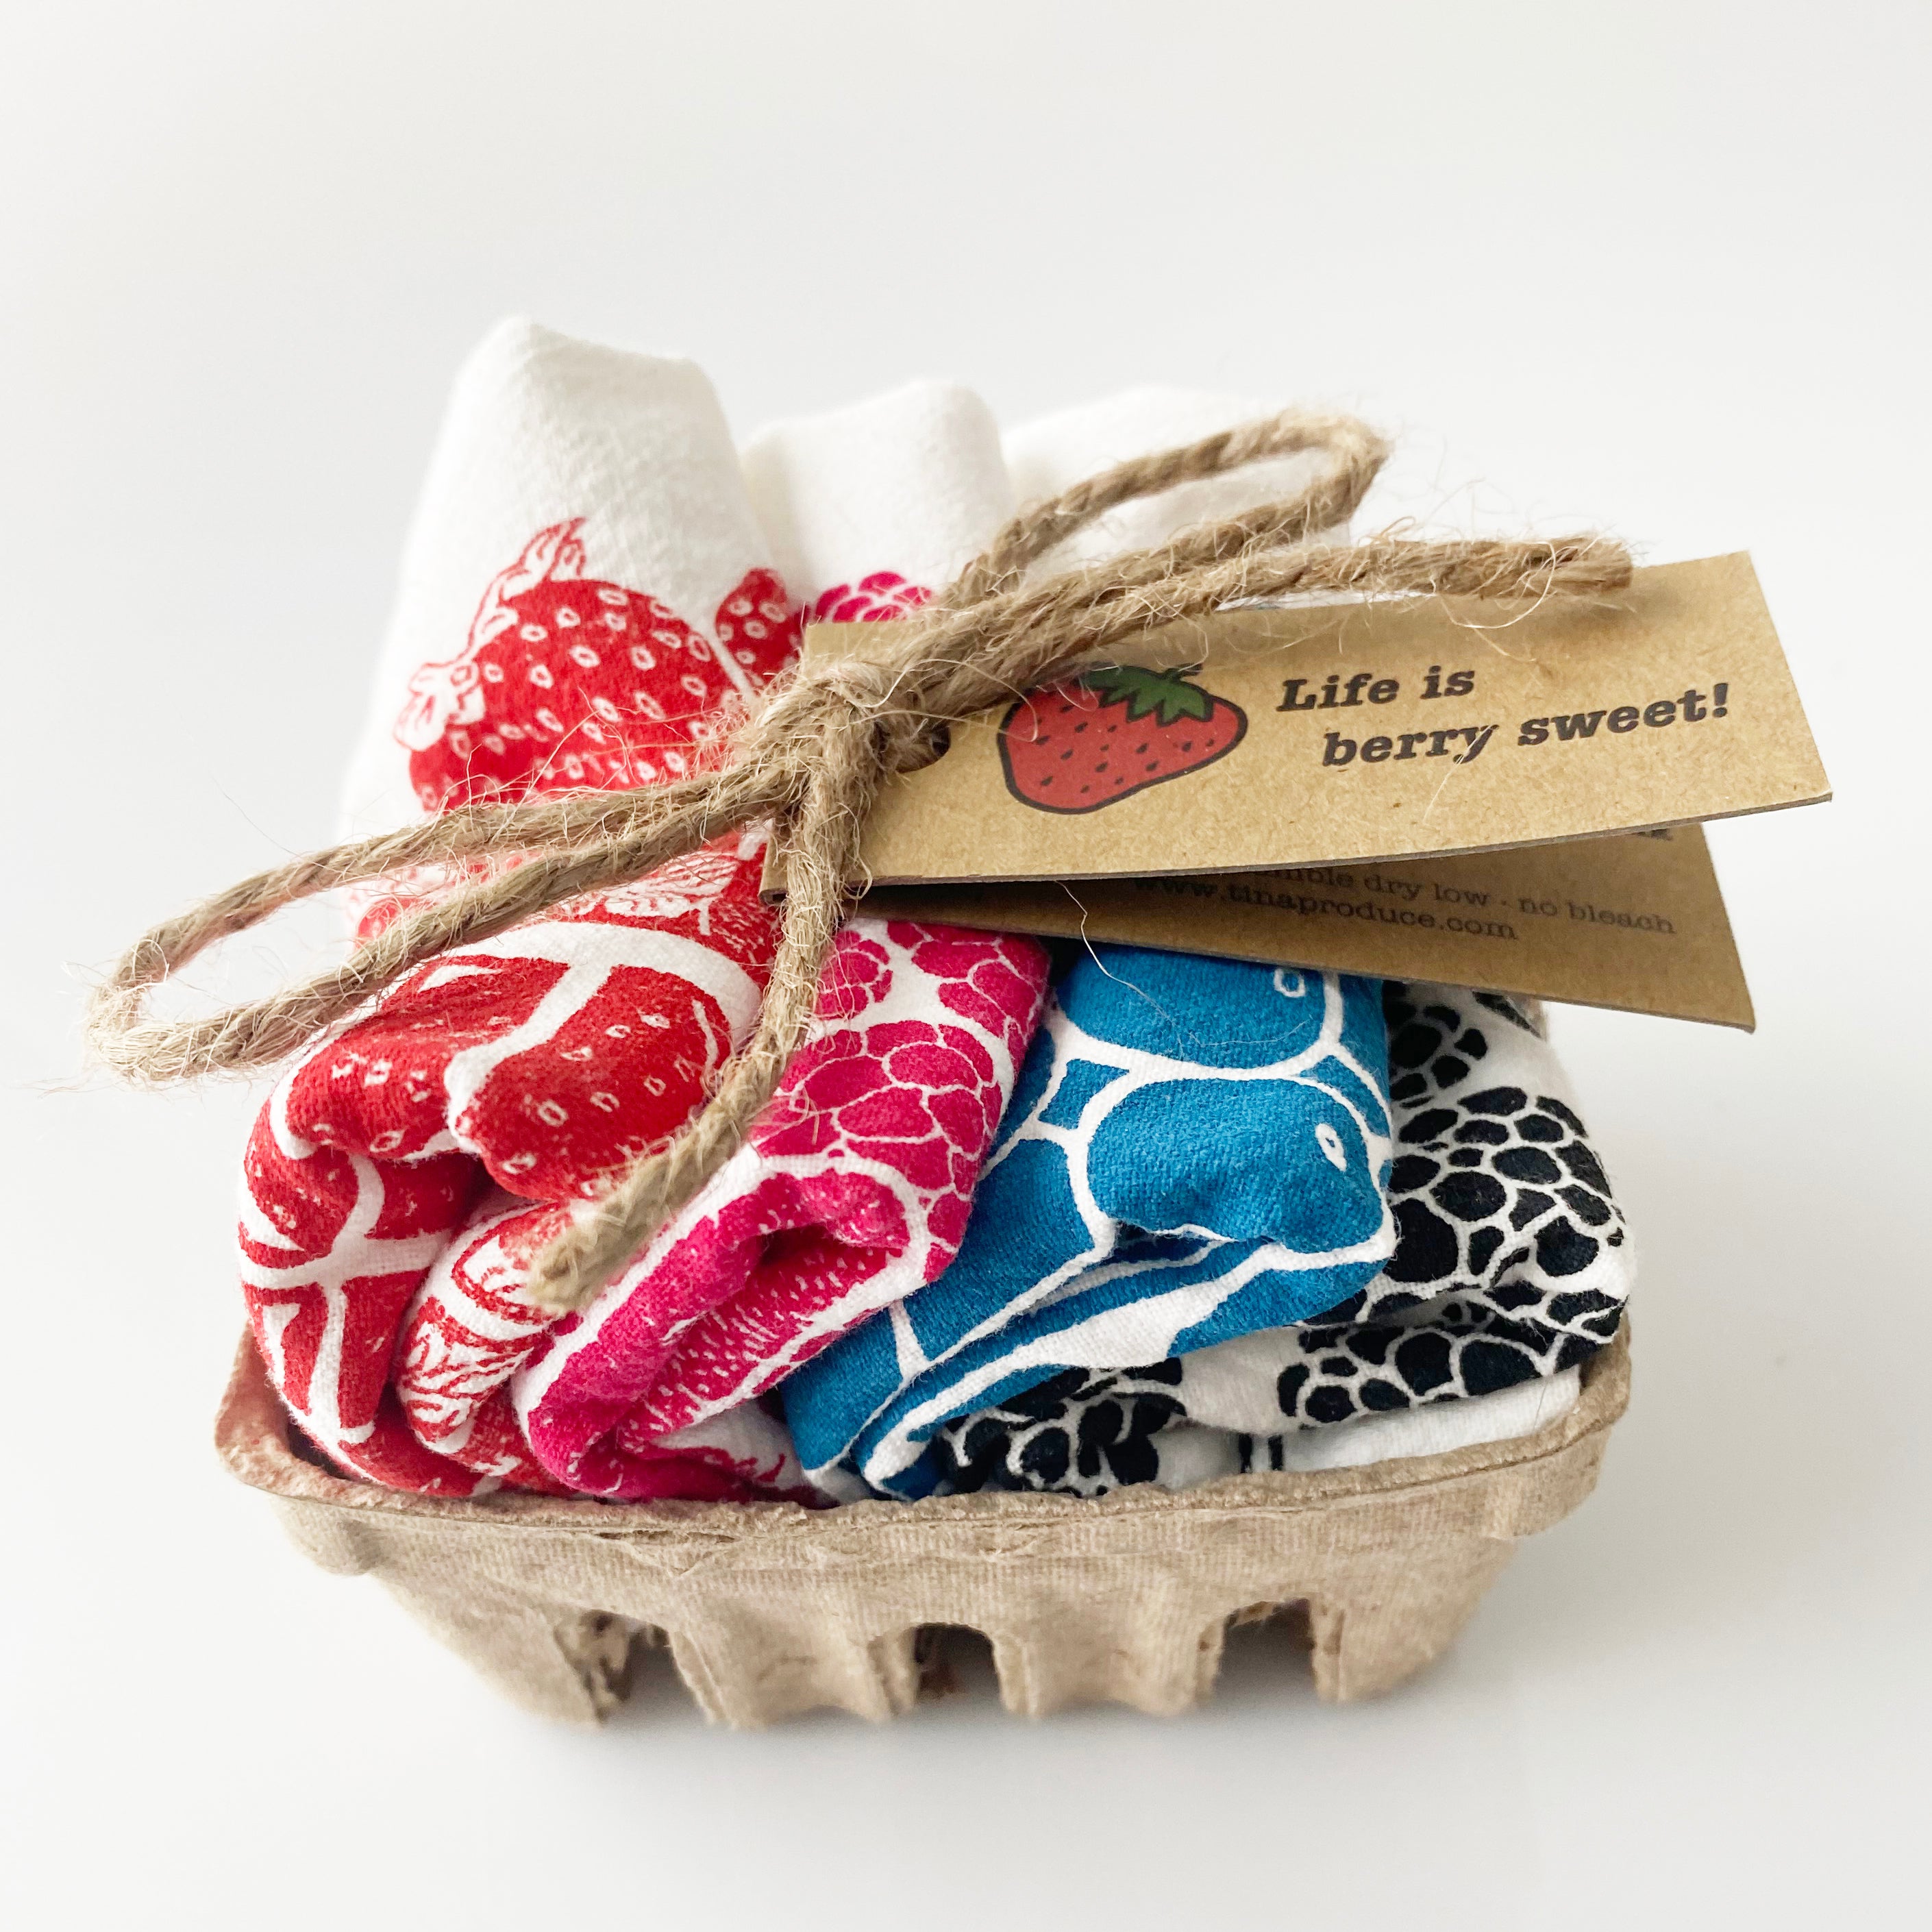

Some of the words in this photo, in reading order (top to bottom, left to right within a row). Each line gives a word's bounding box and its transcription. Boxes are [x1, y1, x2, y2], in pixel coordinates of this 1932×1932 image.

[1275, 673, 1400, 712] Life
[1420, 665, 1476, 699] is
[1321, 723, 1498, 767] berry
[1517, 683, 1730, 746] sweet!
[1364, 874, 1424, 900] dry
[1433, 882, 1491, 908] low
[1518, 897, 1558, 917] no
[1567, 900, 1676, 934] bleach
